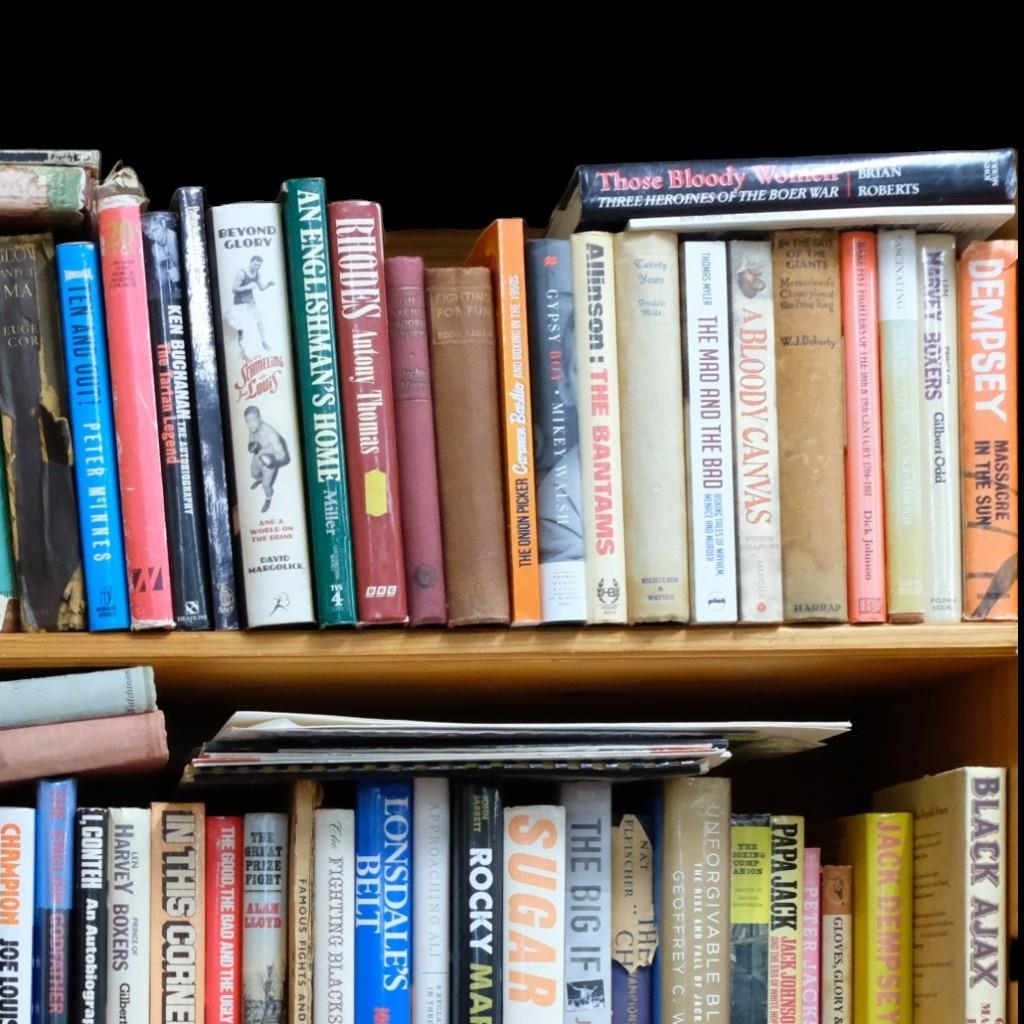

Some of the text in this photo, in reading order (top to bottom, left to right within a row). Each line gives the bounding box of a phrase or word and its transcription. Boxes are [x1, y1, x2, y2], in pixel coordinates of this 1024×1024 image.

[596, 170, 663, 192] Those
[668, 164, 747, 193] Bloody
[598, 186, 839, 208] THREE HEROINES OF THE BOER WAR
[858, 167, 902, 179] BRIAN
[858, 183, 920, 197] ROBERTS
[219, 225, 276, 239] BEYOND
[224, 237, 273, 250] GLORY
[335, 218, 382, 321] RHODES
[967, 257, 1008, 422] DEMPSEY
[793, 603, 842, 613] HARRAP
[0, 822, 22, 925] CHAMPION
[80, 825, 103, 889] CONTEH
[114, 823, 134, 895] HARVEY
[969, 776, 1001, 989] BLACK AJAX
[355, 854, 381, 933] BELT
[383, 797, 410, 991] LONSDALE'S
[469, 848, 494, 955] ROCKY
[506, 814, 558, 1008] SUGAR
[113, 903, 129, 972] BOXERS
[119, 982, 131, 1024] Gilbert
